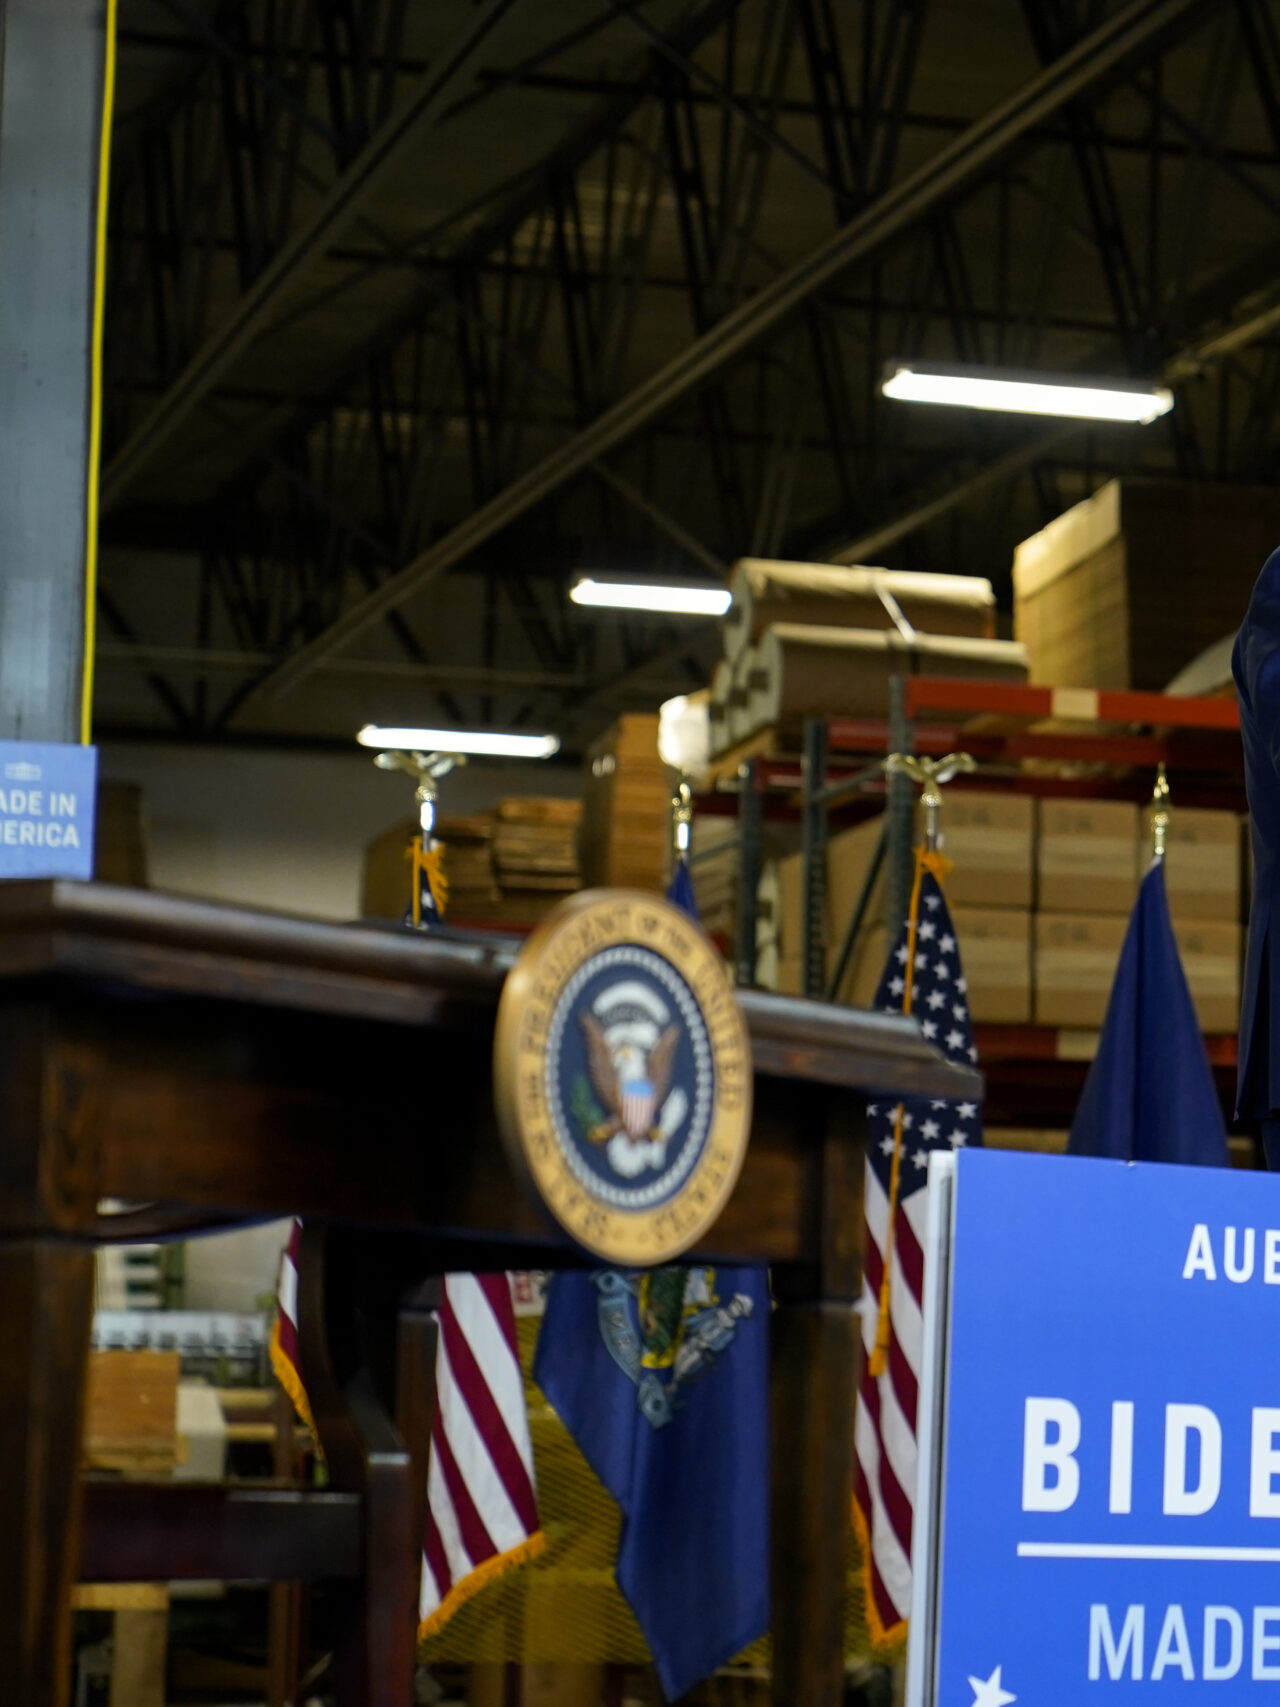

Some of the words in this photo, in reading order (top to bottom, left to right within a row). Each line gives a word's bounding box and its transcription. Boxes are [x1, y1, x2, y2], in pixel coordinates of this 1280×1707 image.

[0, 789, 42, 816] ADE
[50, 792, 77, 817] IN
[0, 820, 80, 848] ERICA
